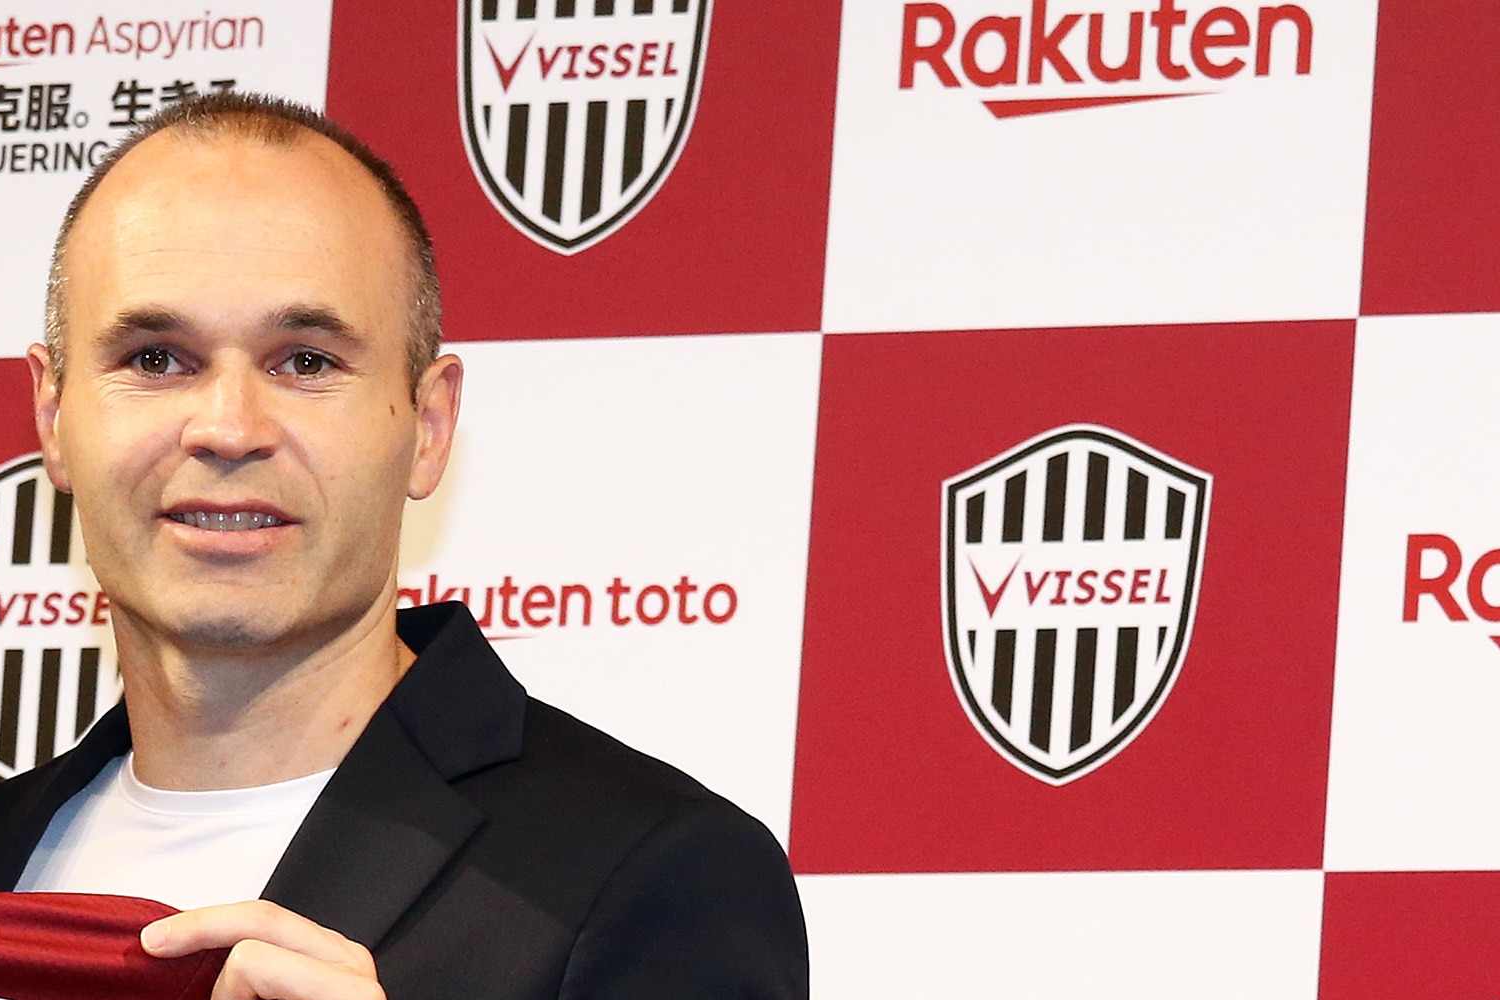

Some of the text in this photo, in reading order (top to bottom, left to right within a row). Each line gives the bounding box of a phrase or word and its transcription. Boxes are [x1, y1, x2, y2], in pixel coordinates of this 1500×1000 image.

[85, 11, 264, 60] Aspyrian
[898, 0, 1314, 90] Rakuten
[538, 42, 678, 79] VISSEL
[606, 575, 738, 626] toto
[1023, 568, 1171, 606] VISSEL
